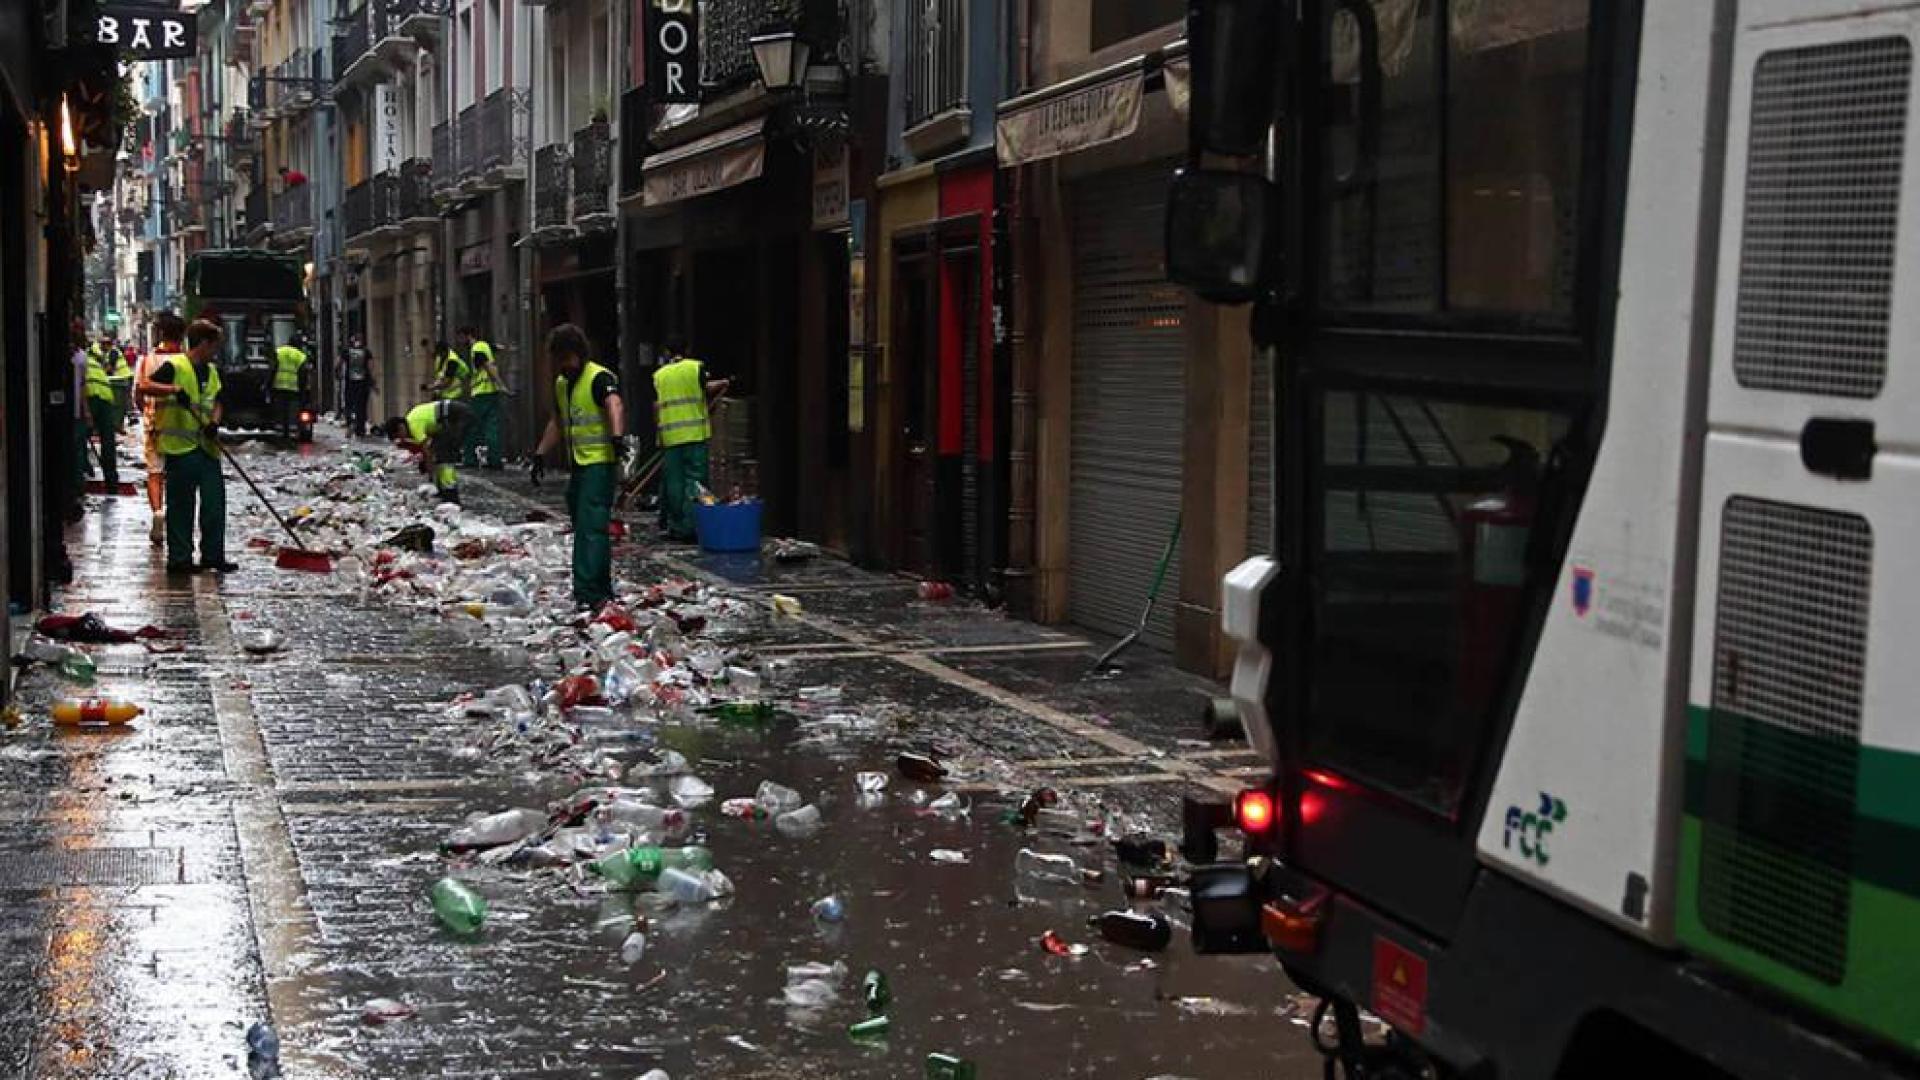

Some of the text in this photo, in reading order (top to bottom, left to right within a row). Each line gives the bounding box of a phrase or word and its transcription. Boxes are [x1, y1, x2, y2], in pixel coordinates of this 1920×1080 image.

[98, 15, 186, 48] BAR
[384, 91, 397, 173] HOSTAL
[1504, 806, 1553, 866] FCC
